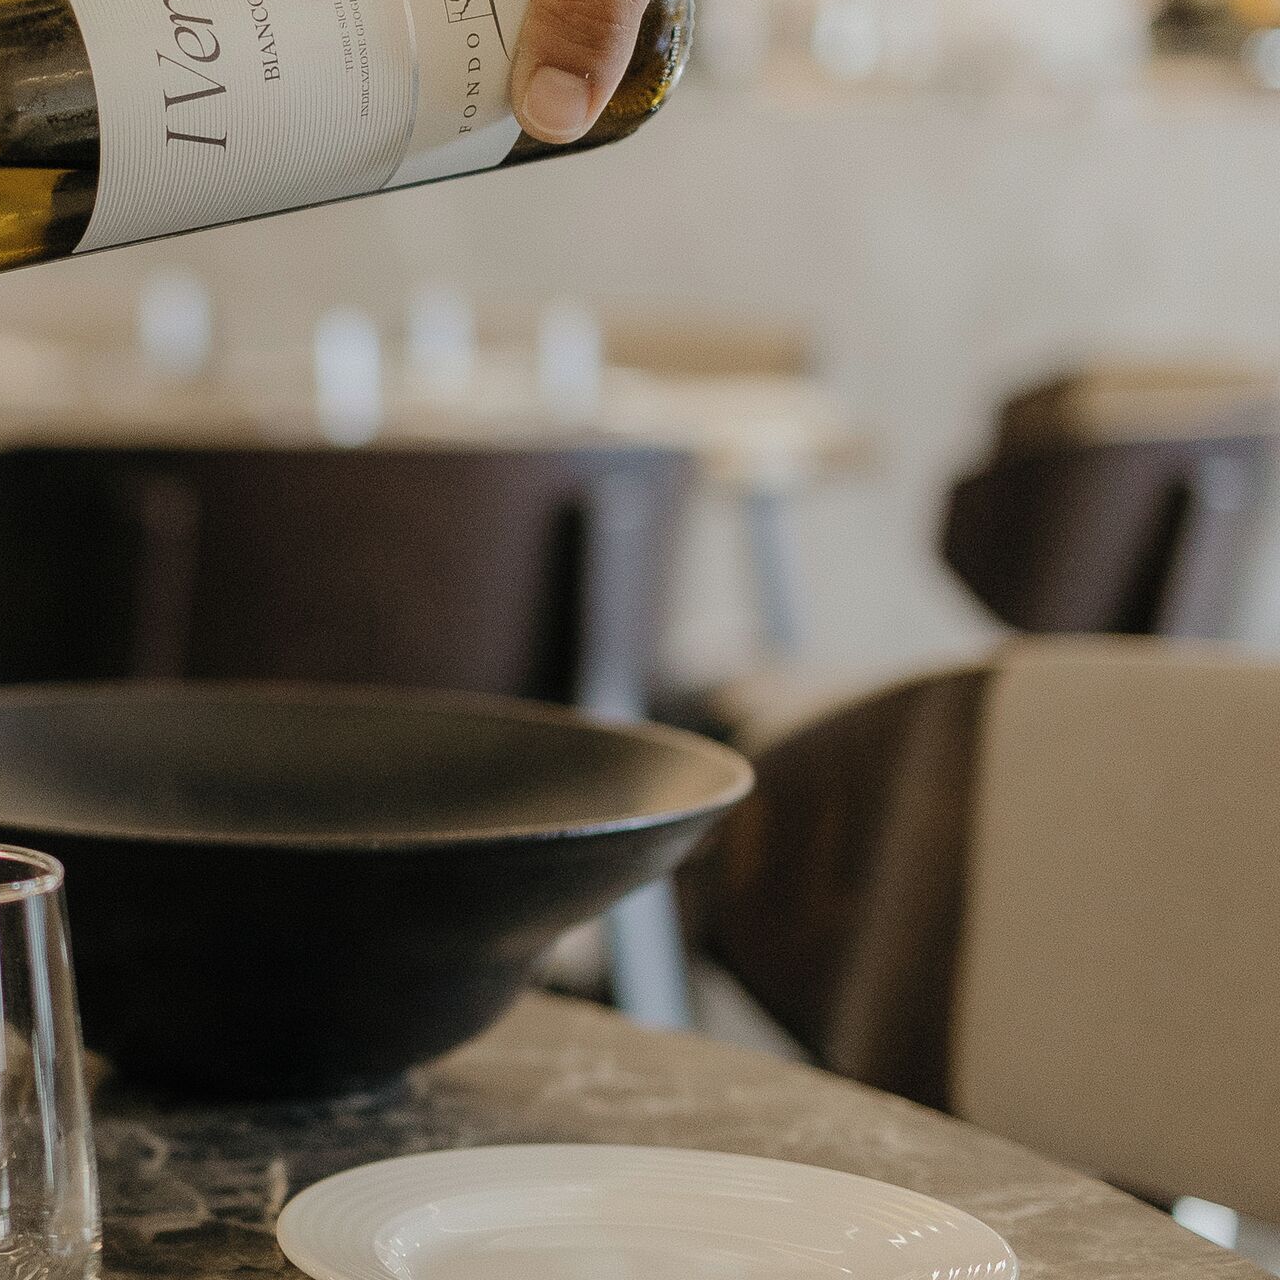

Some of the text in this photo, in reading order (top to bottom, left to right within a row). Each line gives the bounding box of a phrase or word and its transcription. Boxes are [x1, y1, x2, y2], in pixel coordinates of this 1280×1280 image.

[341, 31, 355, 73] TERRE
[358, 38, 370, 118] INDICAZIONE
[458, 32, 481, 134] FONDO
[166, 125, 228, 151] I
